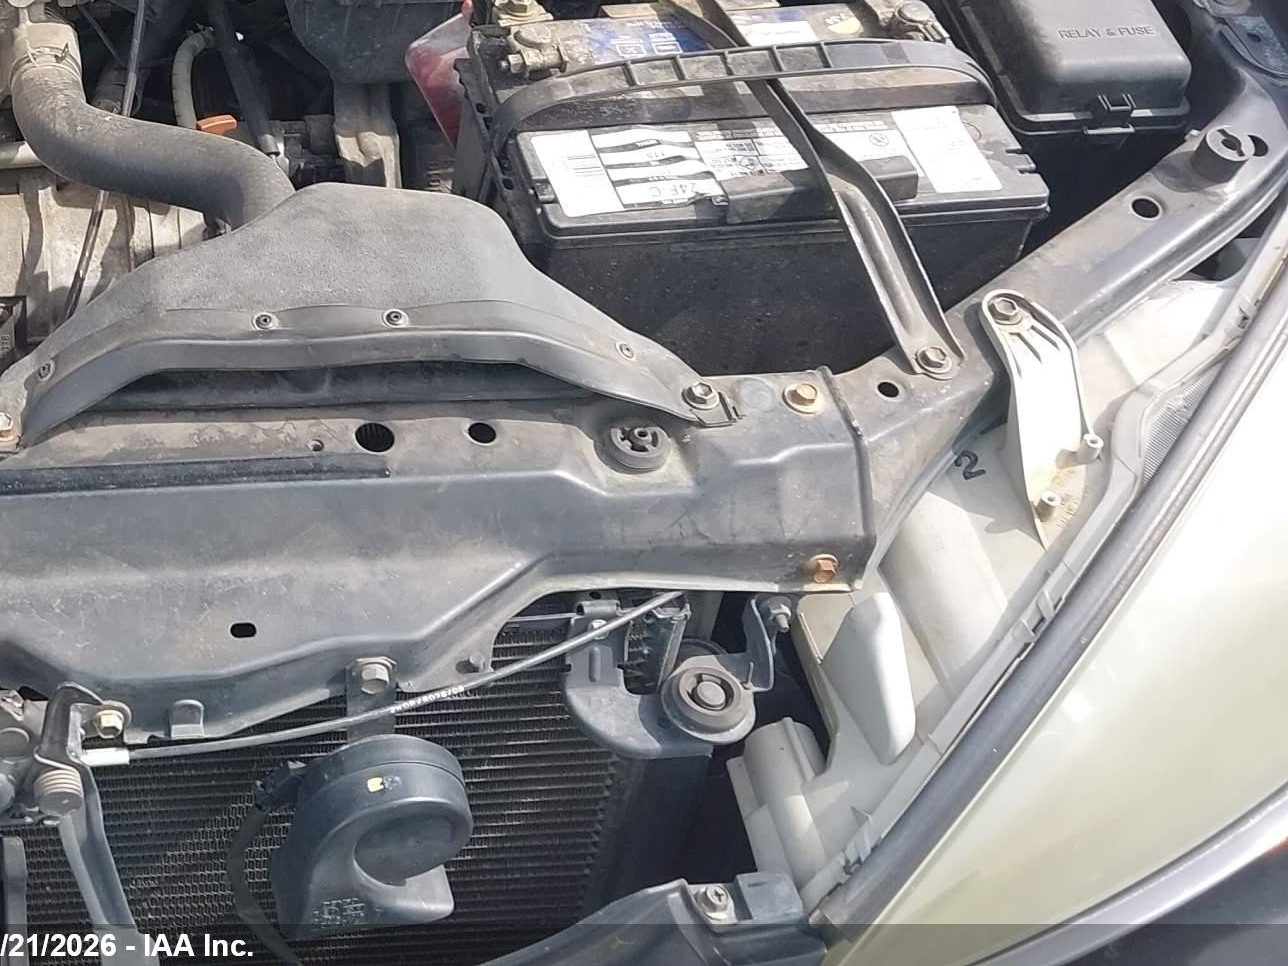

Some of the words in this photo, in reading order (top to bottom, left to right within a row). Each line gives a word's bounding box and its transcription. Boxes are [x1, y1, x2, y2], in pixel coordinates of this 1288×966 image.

[1057, 28, 1101, 39] RELAY
[1106, 27, 1117, 37] &
[1118, 25, 1155, 37] FUSE
